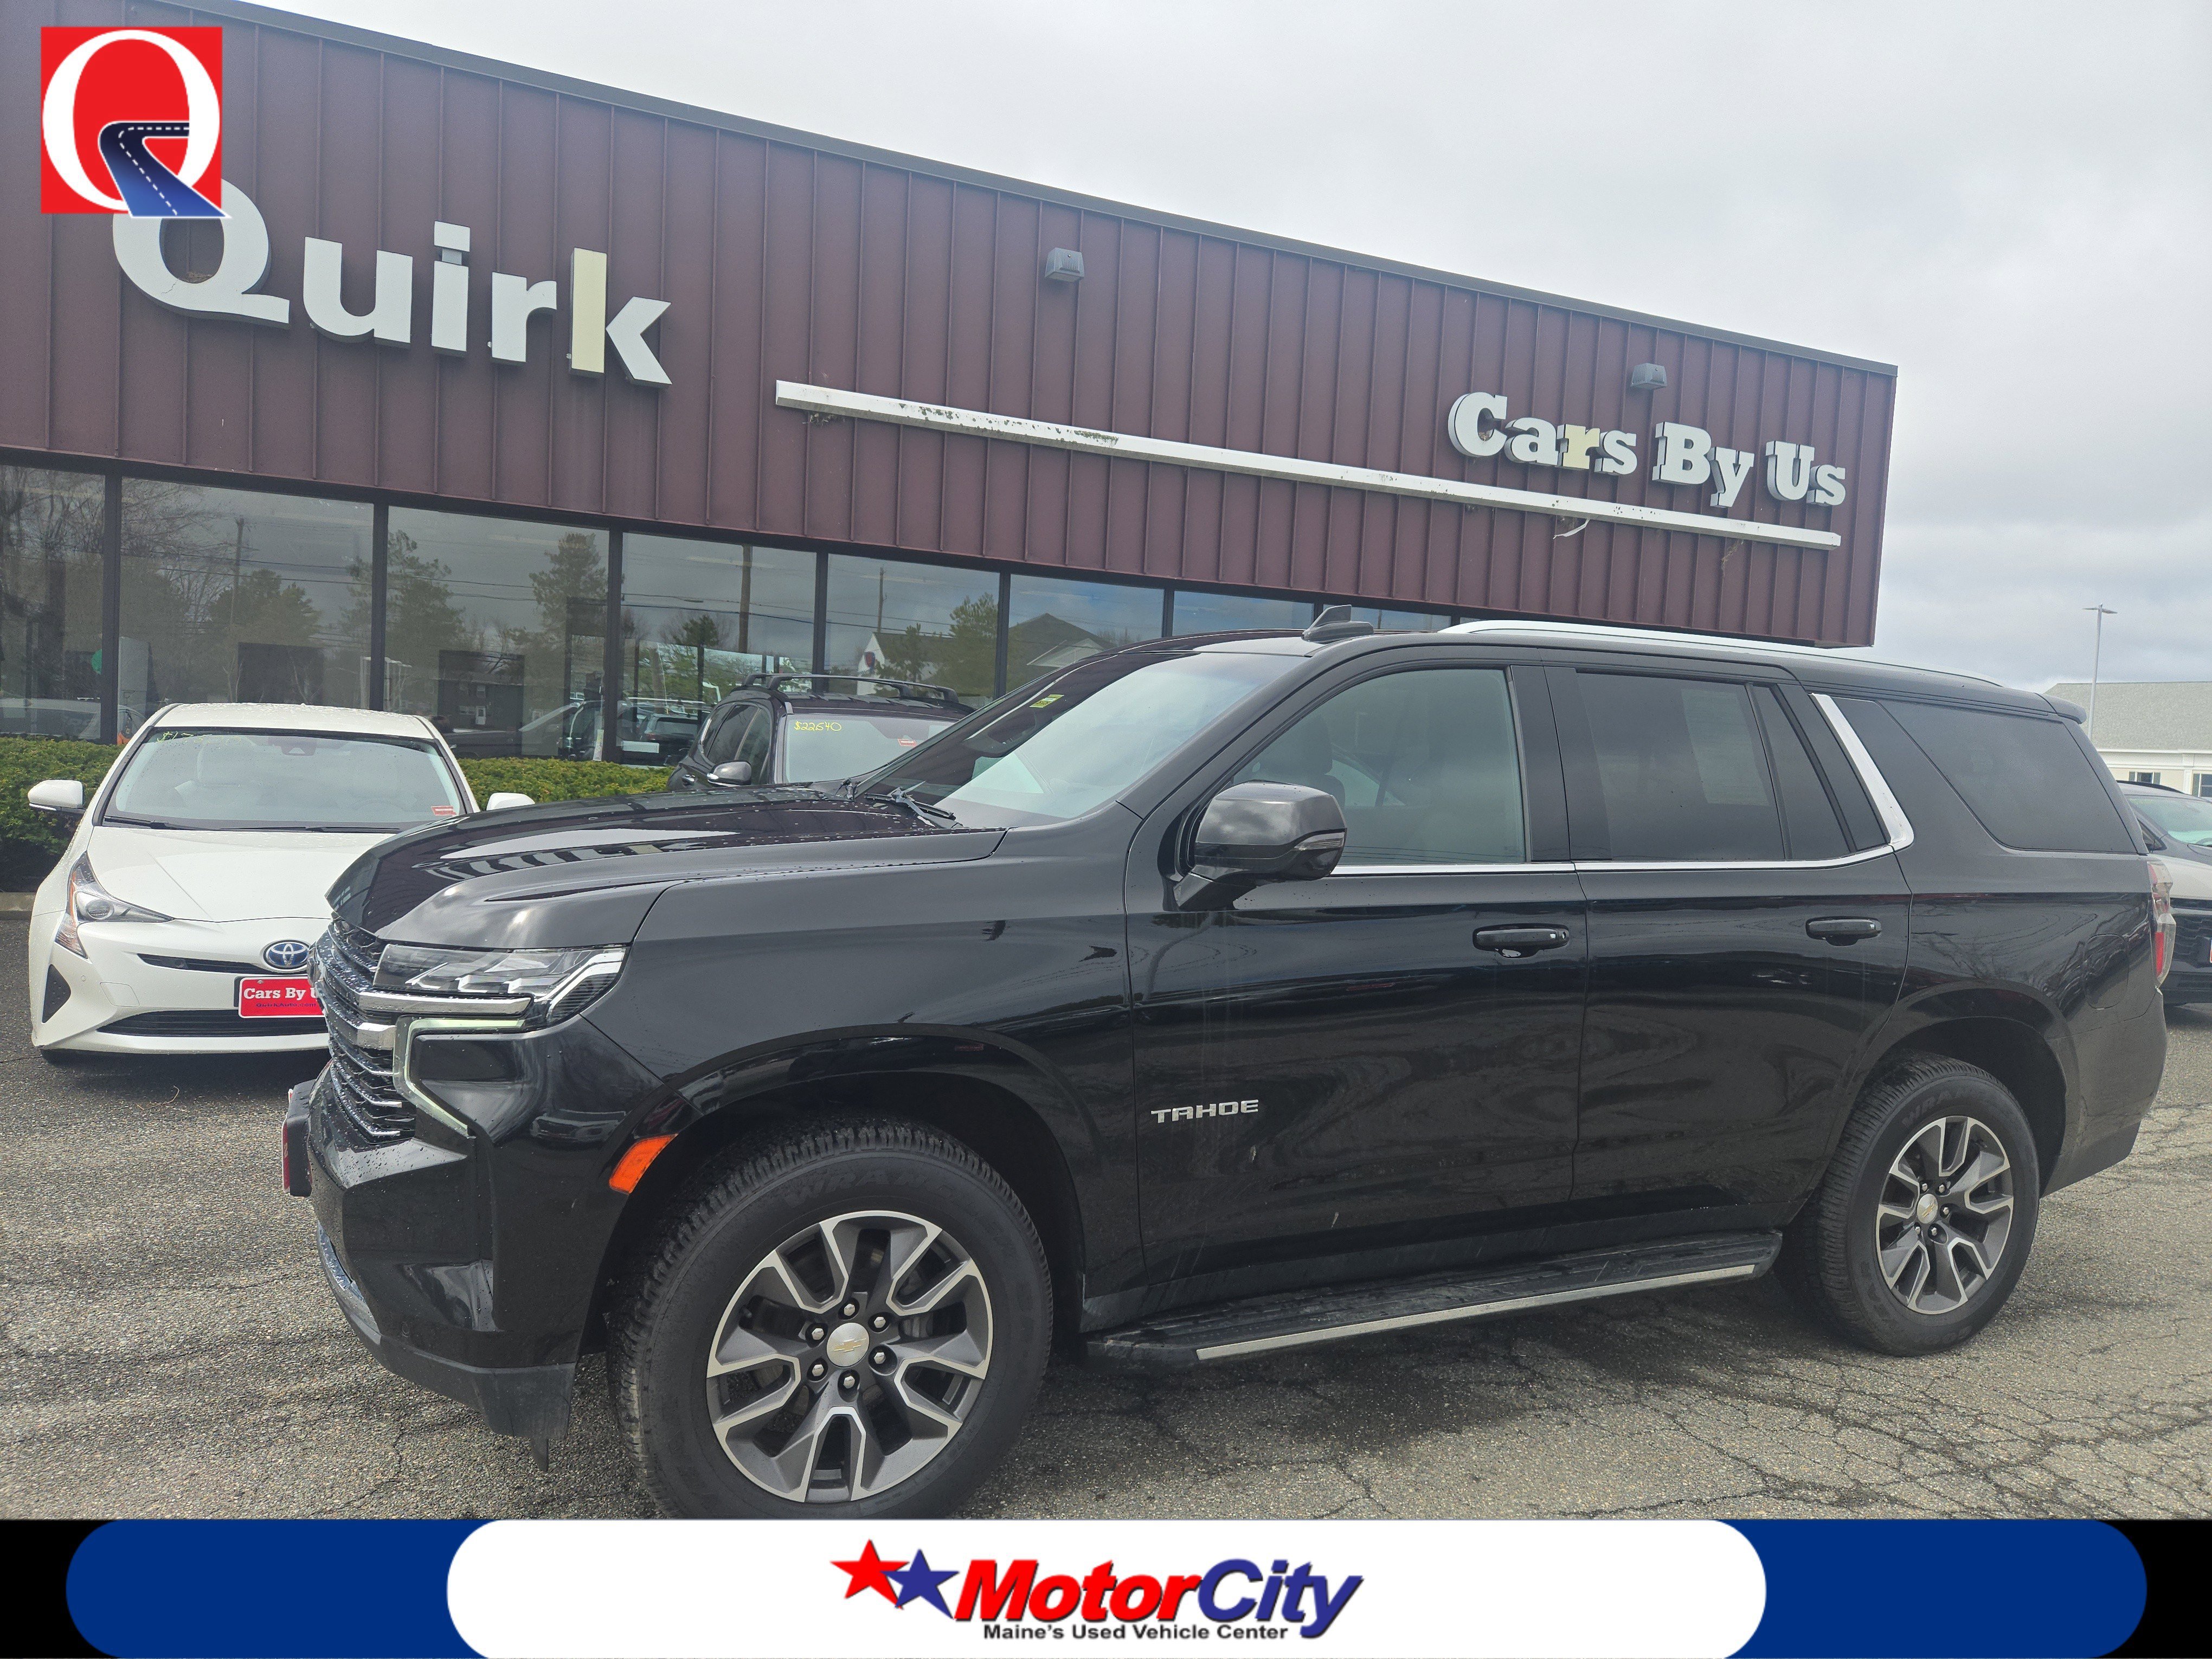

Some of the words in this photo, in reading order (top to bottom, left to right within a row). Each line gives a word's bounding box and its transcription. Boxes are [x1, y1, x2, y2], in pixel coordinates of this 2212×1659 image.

[113, 178, 672, 388] Quirk
[1448, 391, 1637, 475] Cars
[1652, 421, 1755, 508] By
[1765, 440, 1846, 506] Us
[243, 988, 281, 999] Cars
[285, 987, 306, 1000] By
[1151, 1099, 1258, 1123] TAHOE
